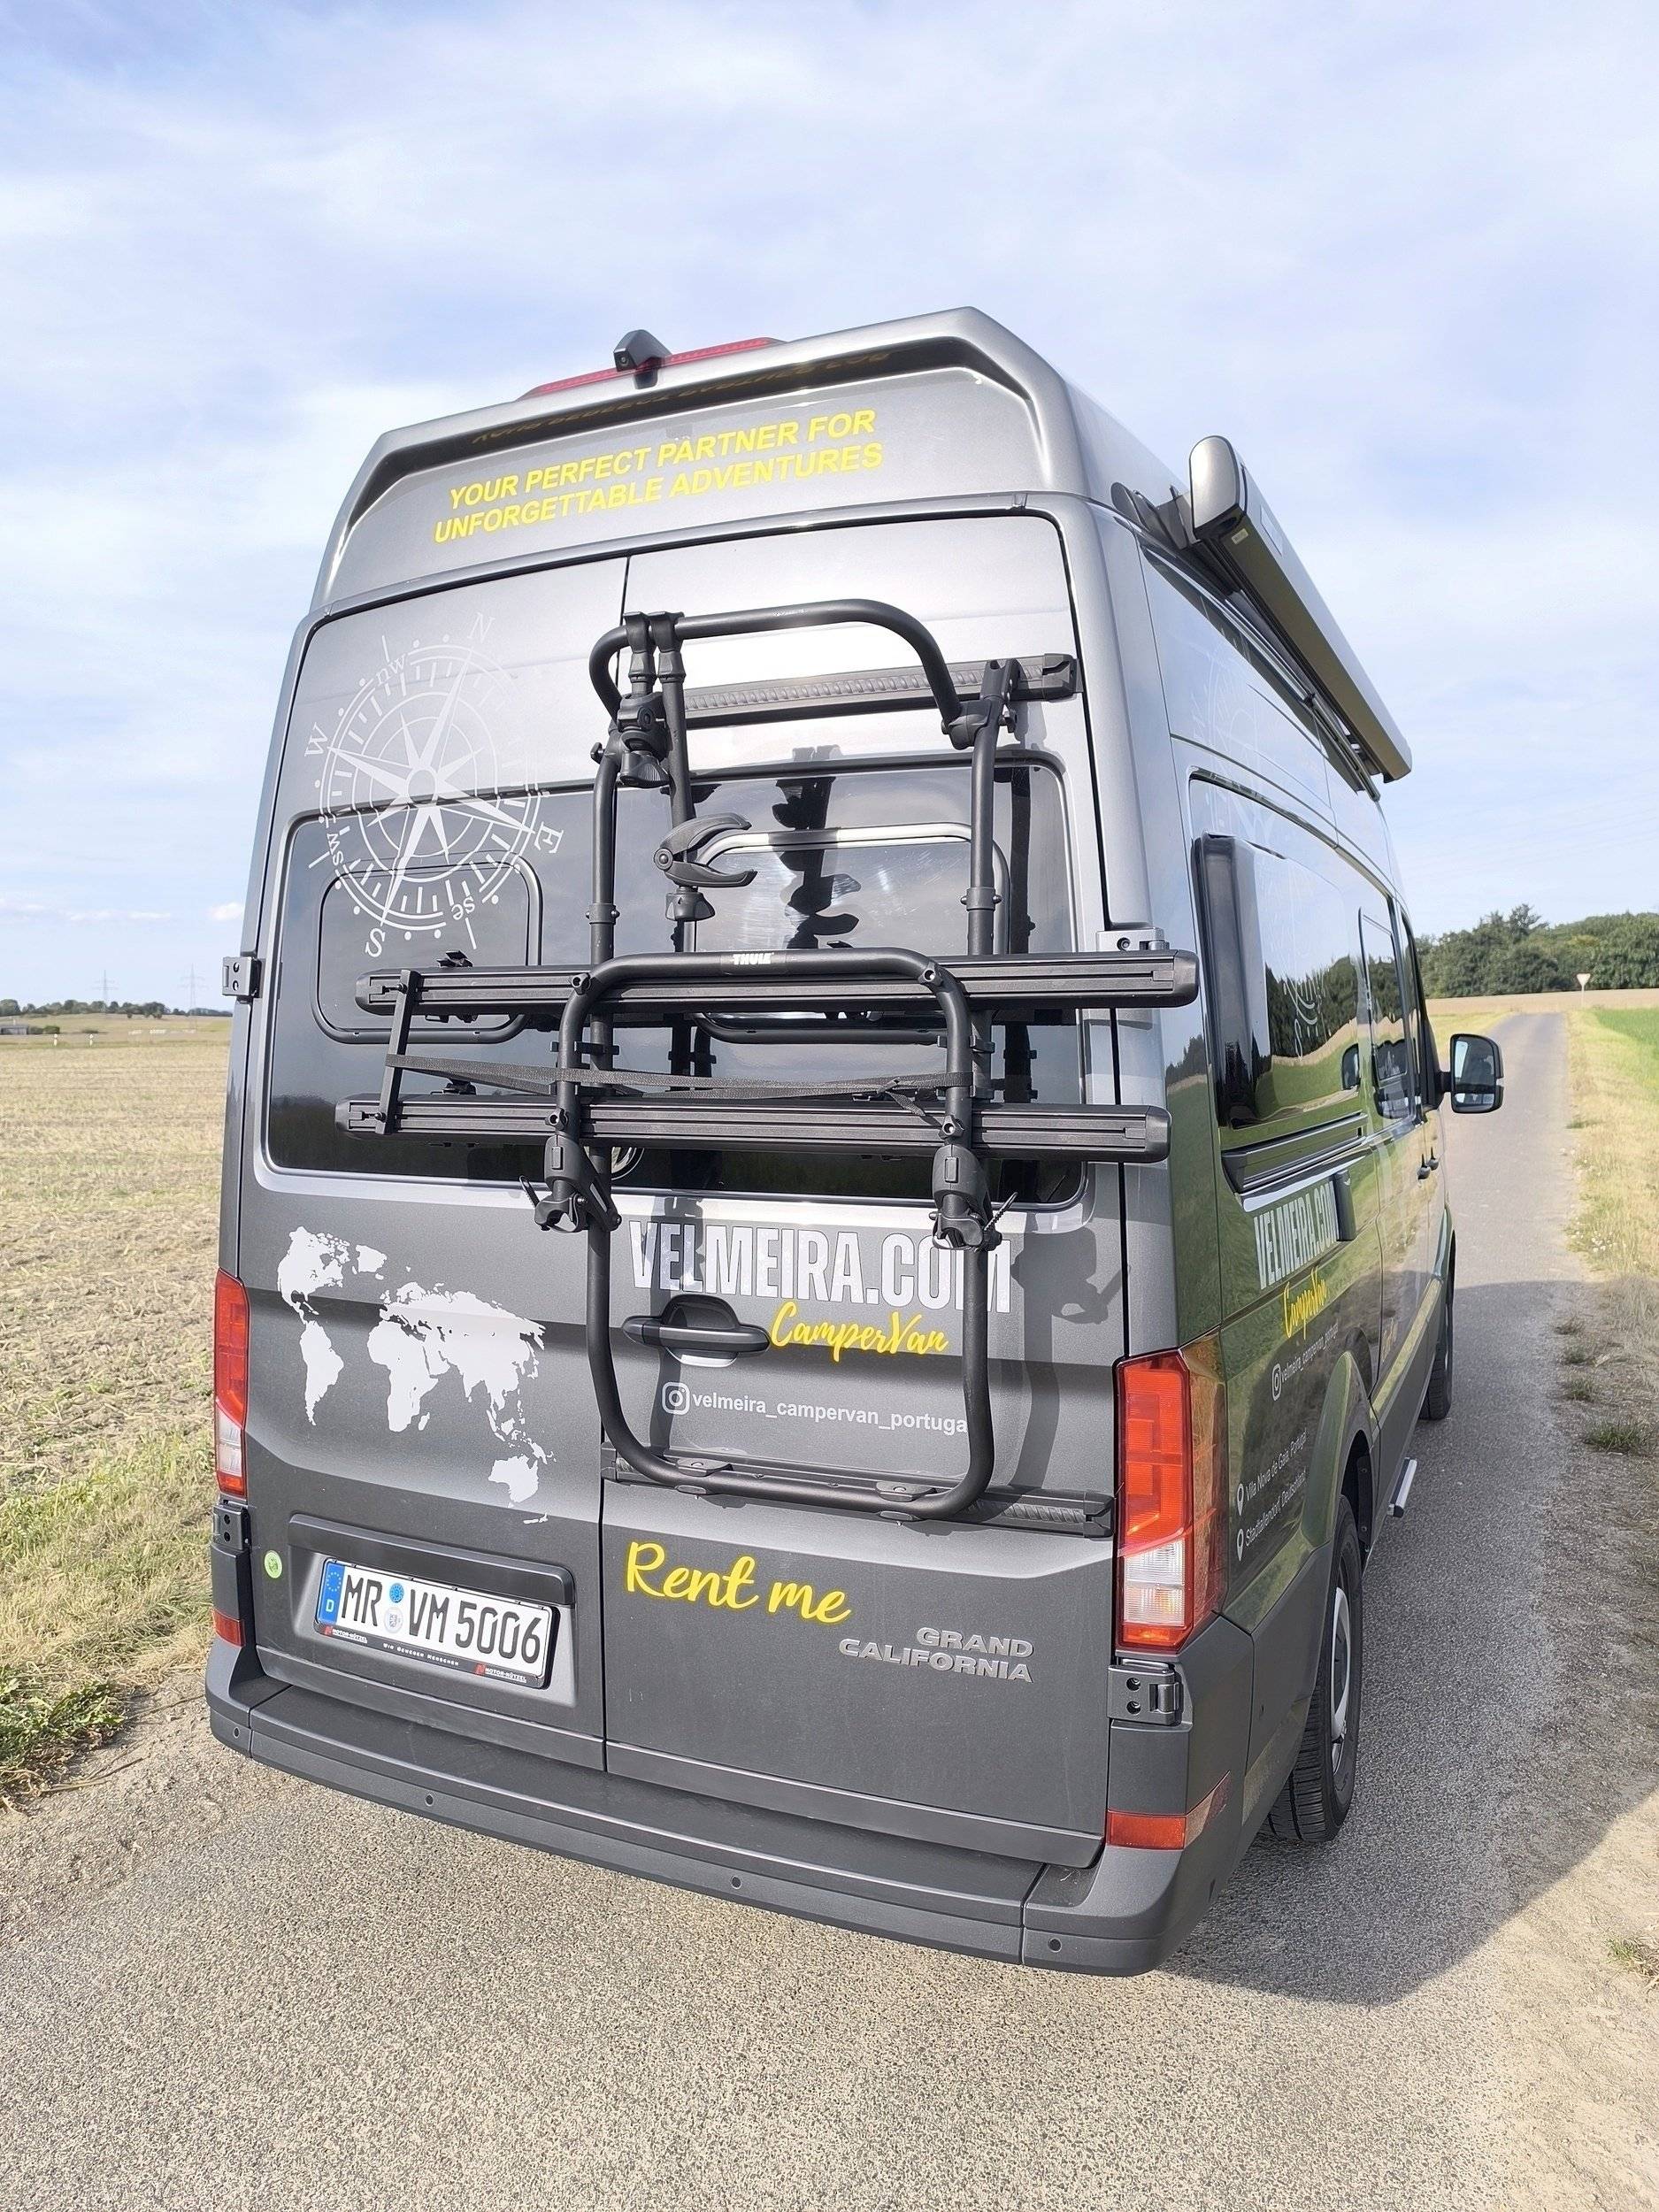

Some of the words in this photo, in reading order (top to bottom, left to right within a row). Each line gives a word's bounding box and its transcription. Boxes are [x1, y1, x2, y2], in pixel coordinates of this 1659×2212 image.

[449, 472, 518, 510] YOUR
[524, 445, 651, 493] PERFECT
[657, 424, 798, 467] PARTNER
[806, 409, 877, 443] FOR
[434, 476, 663, 543] UNFORGETTABLE
[668, 442, 883, 497] ADVENTURES
[534, 821, 564, 855] E
[365, 927, 385, 958] S
[733, 952, 774, 965] THULE
[628, 1220, 1011, 1313] VELMEIRA.COM
[1253, 1180, 1340, 1291] VELMEIRA.COM
[768, 1301, 949, 1363] CamperVan
[692, 1392, 969, 1436] velmeira_campervan_portuga
[626, 1540, 759, 1609] Rent
[767, 1578, 852, 1624] me
[325, 1598, 334, 1613] D
[342, 1574, 383, 1627] MR
[408, 1588, 450, 1644] VM
[454, 1600, 542, 1664] 5006
[916, 1626, 1035, 1658] GRAND
[838, 1638, 1034, 1684] CALIFORNIA
